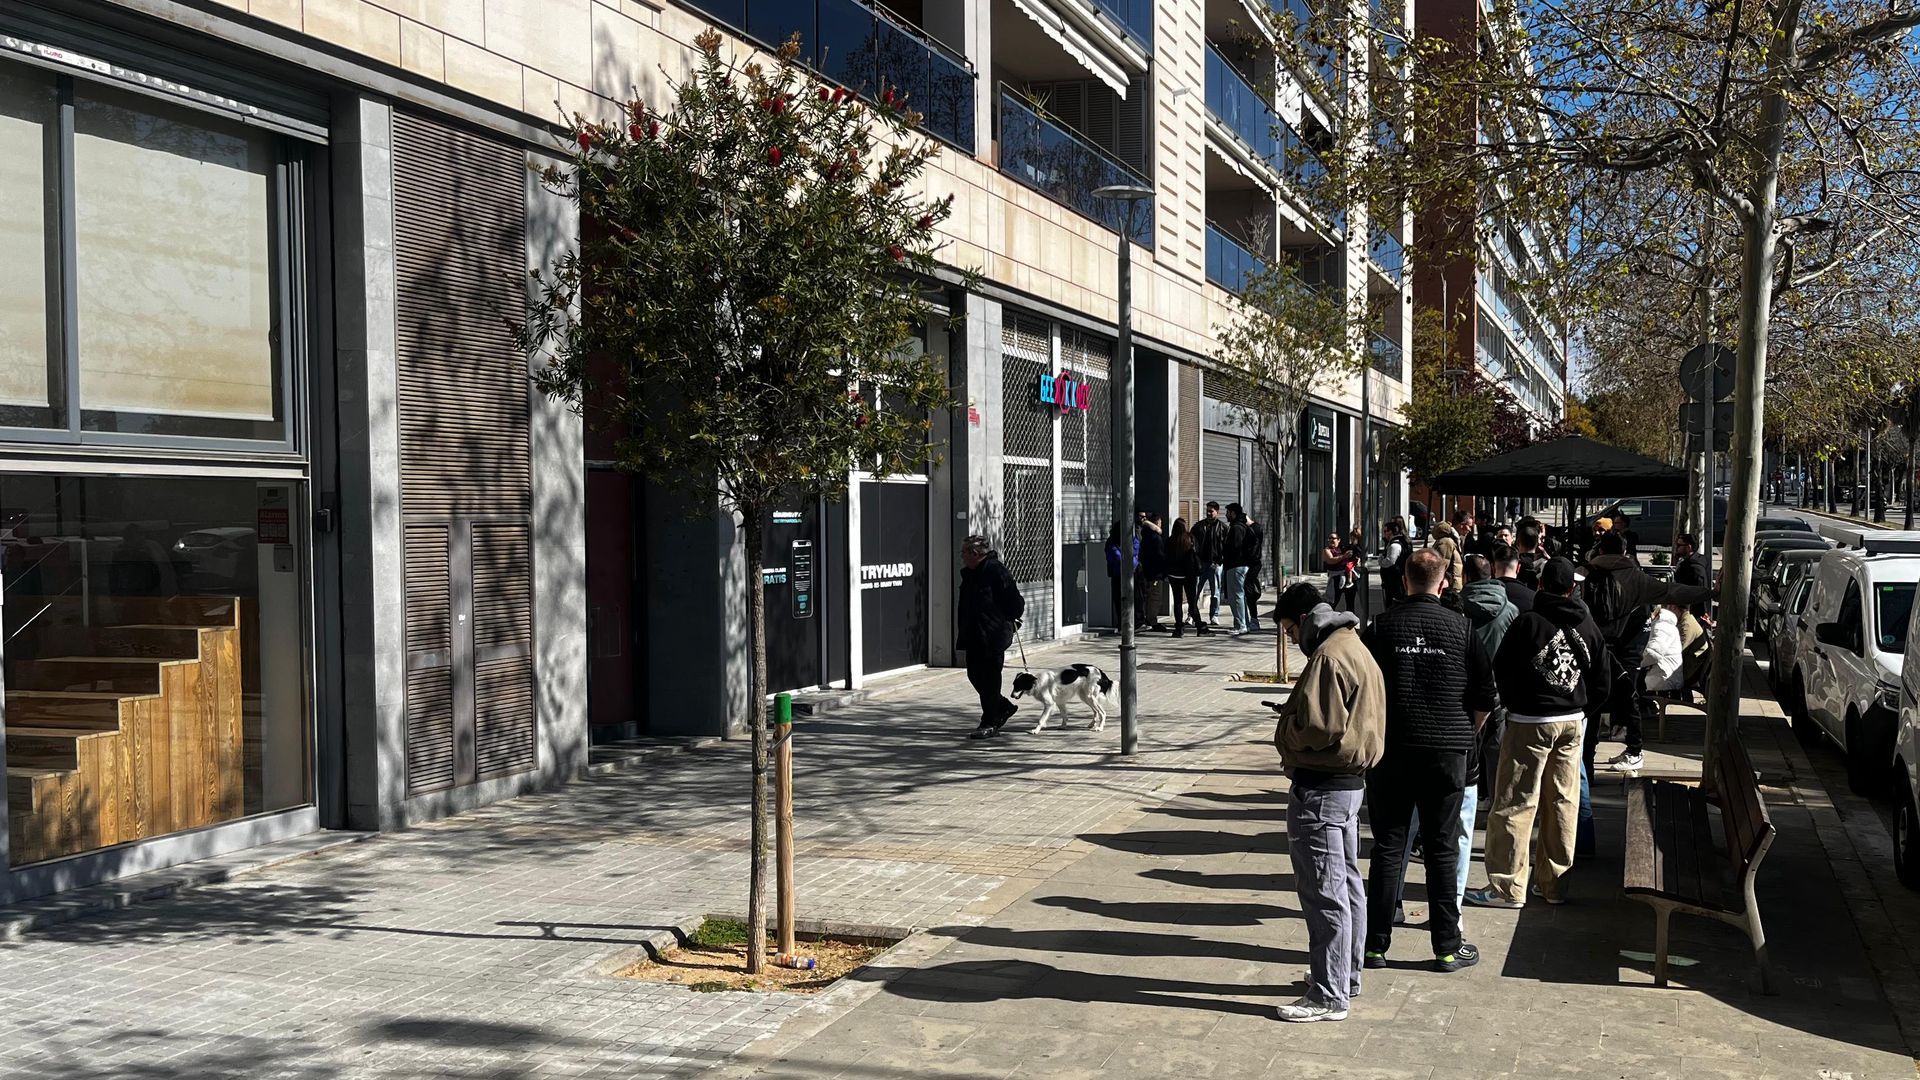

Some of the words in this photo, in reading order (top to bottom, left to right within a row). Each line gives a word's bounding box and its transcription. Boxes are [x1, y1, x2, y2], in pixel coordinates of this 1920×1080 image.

[1559, 476, 1591, 486] Kedke
[861, 563, 914, 580] TRYHARD
[764, 575, 786, 584] RATIS
